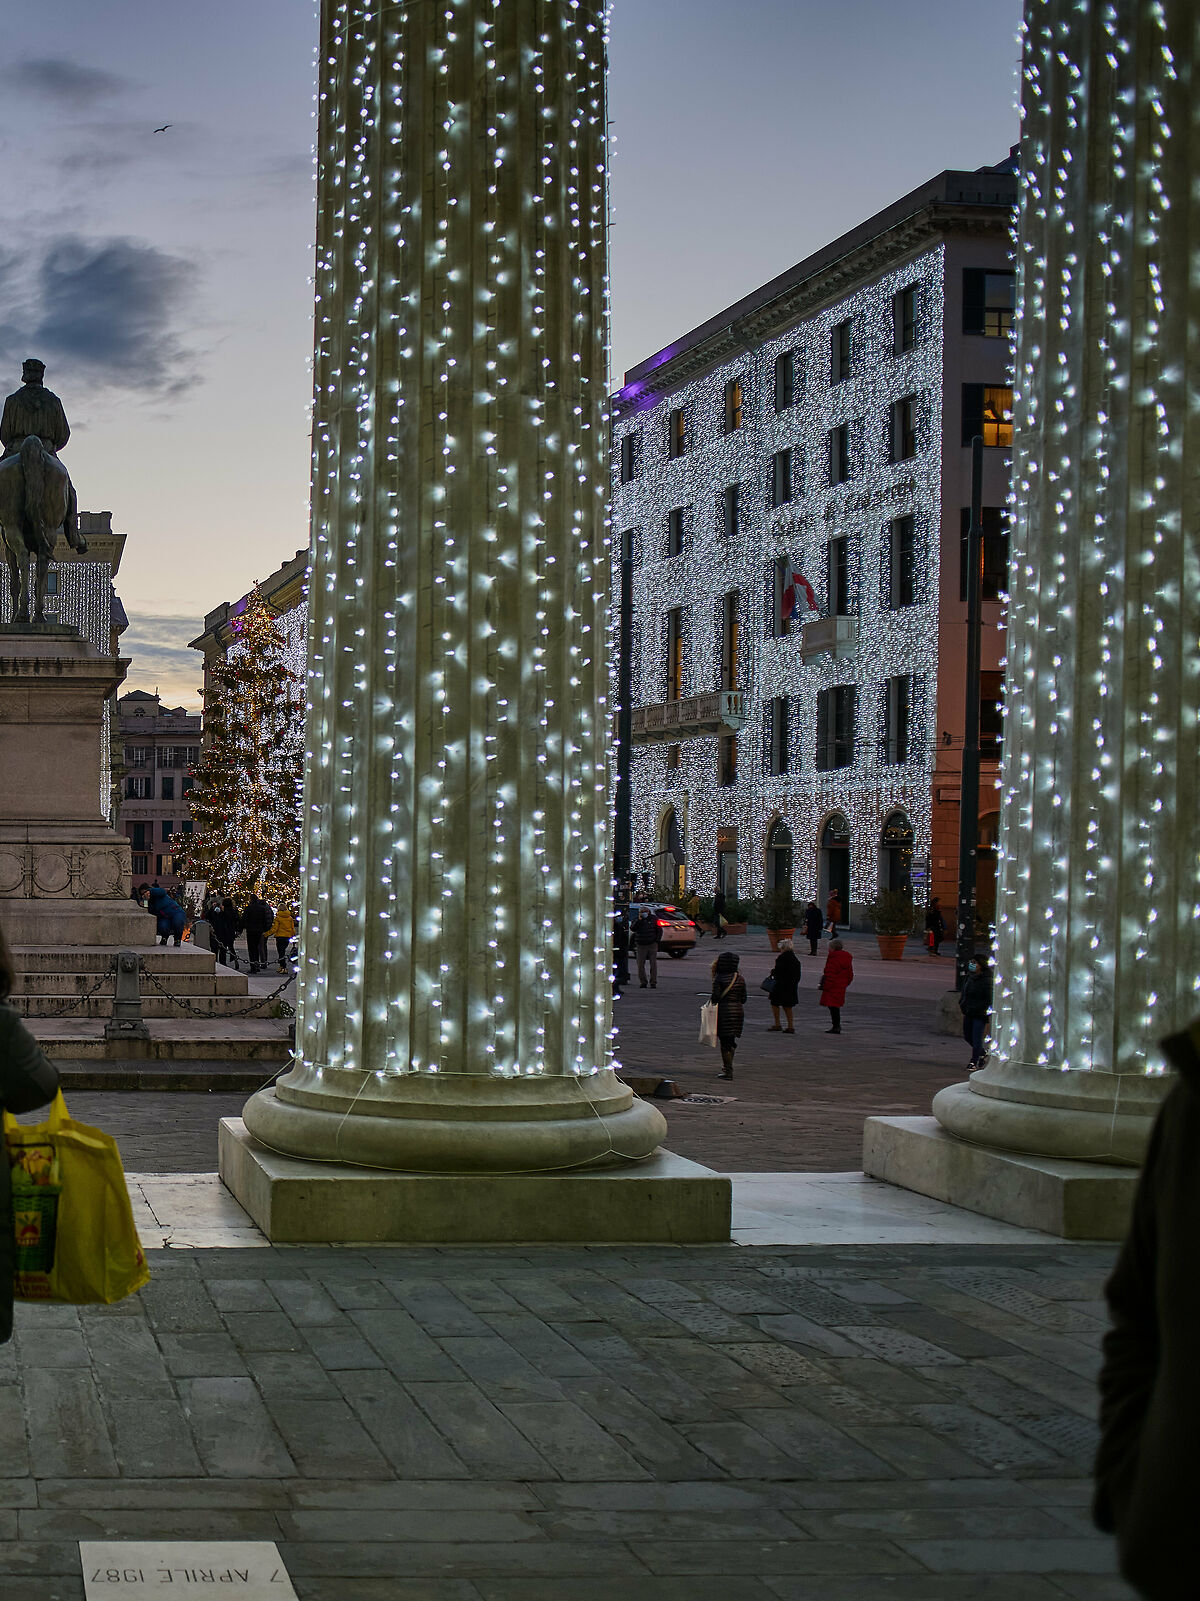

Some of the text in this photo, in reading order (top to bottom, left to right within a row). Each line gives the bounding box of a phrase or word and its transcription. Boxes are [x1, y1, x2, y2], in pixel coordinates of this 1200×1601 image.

[91, 1569, 285, 1583] 7 APRILE 1987
